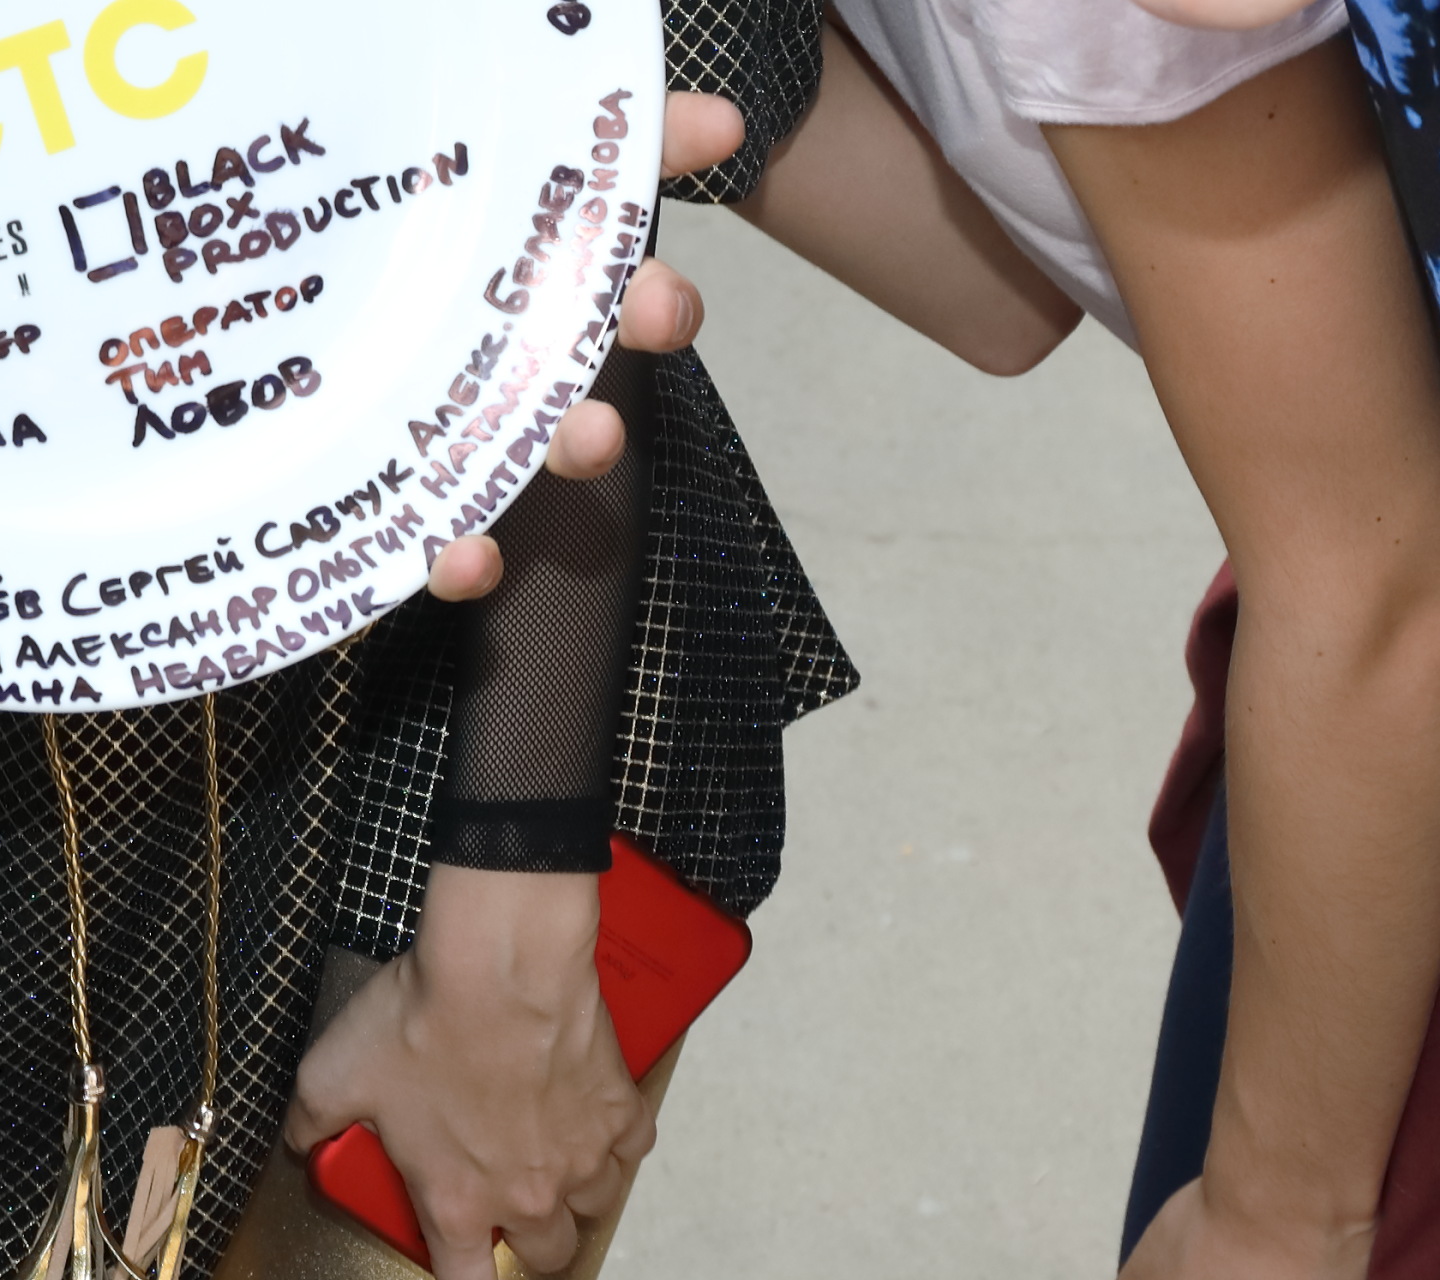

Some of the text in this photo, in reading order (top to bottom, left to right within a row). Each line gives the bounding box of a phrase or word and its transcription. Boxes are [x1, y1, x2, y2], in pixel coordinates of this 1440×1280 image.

[141, 115, 326, 209] BLACK
[154, 191, 261, 253] BOX
[161, 141, 470, 283] PRODUCTION
[97, 274, 324, 368] ОПЕРАТОР
[104, 348, 213, 405] ТИМ
[131, 355, 323, 448] ЛОБОВ
[61, 536, 245, 617] СЕРГЕЙ
[254, 457, 415, 559] САВЧУК
[14, 585, 279, 672] АЛЕКСАНДР
[129, 585, 401, 698] НЕДЕЛЬЧУК
